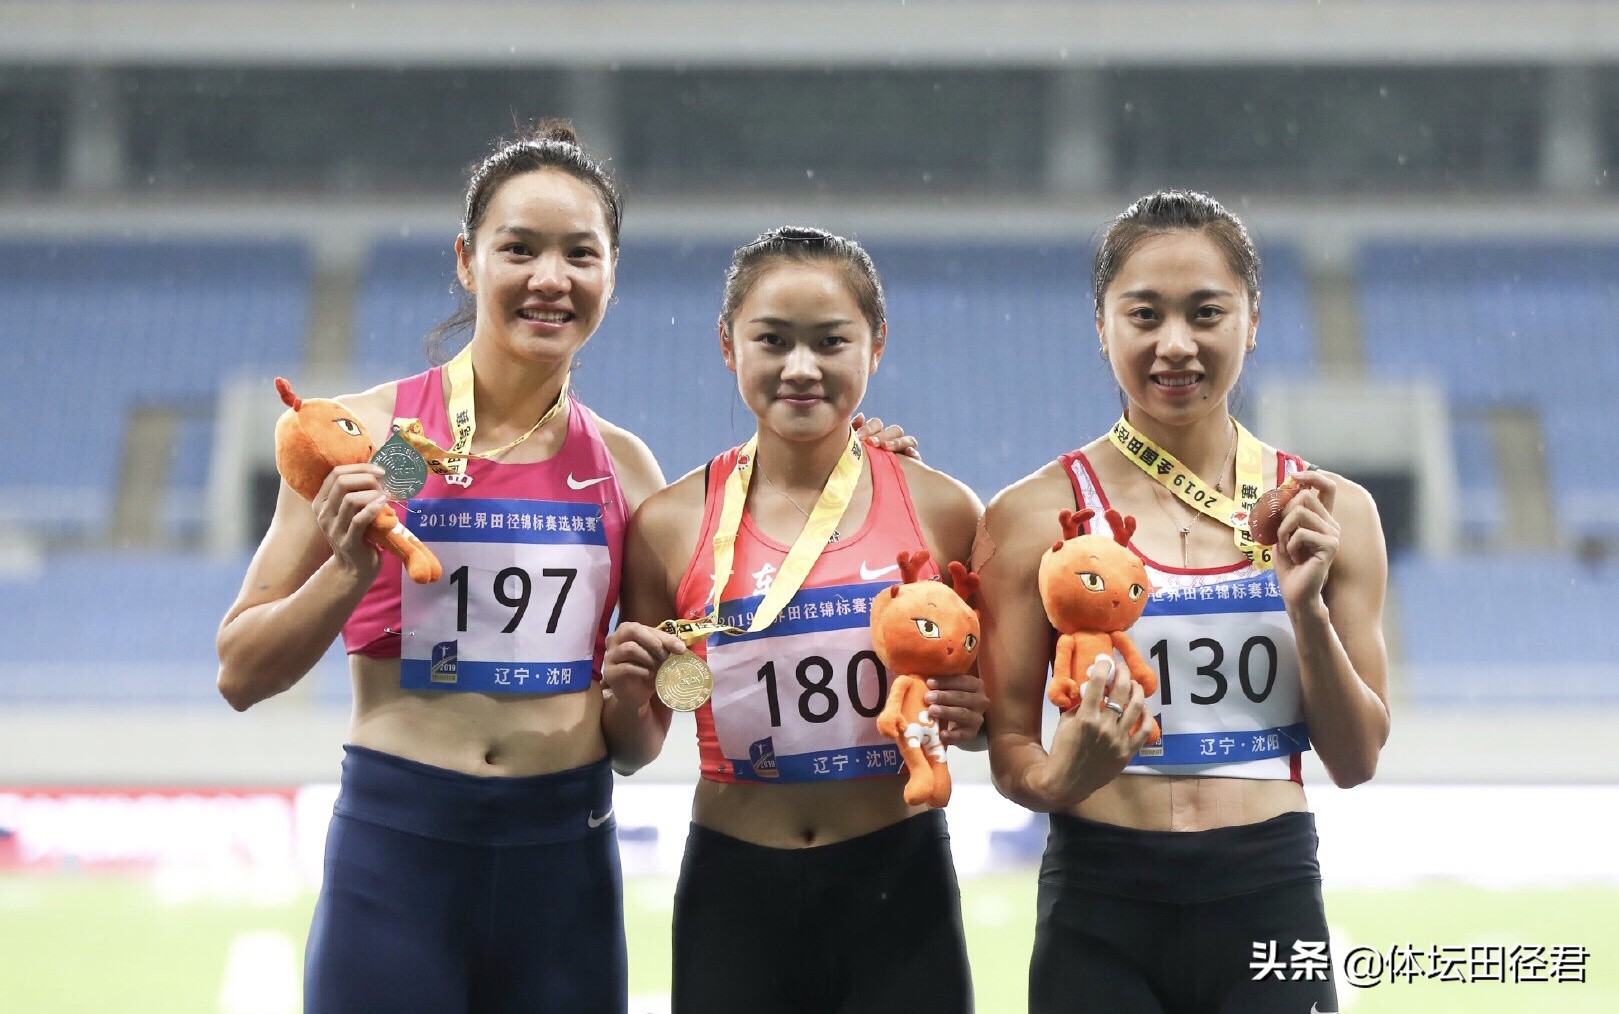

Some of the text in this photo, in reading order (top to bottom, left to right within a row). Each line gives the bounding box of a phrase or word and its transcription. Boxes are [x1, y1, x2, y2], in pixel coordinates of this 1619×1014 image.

[419, 511, 597, 533] 2019世界田径锦标赛选拔赛
[449, 565, 578, 634] 197
[1147, 581, 1284, 603] 世界田径锦标赛选
[439, 664, 456, 672] 2019
[494, 667, 572, 686] 辽宁·沈阳
[1149, 635, 1279, 706] 130
[756, 650, 888, 728] 180
[1200, 733, 1281, 757] 辽宁·沈阳
[812, 749, 897, 775] 辽宁·沈阳
